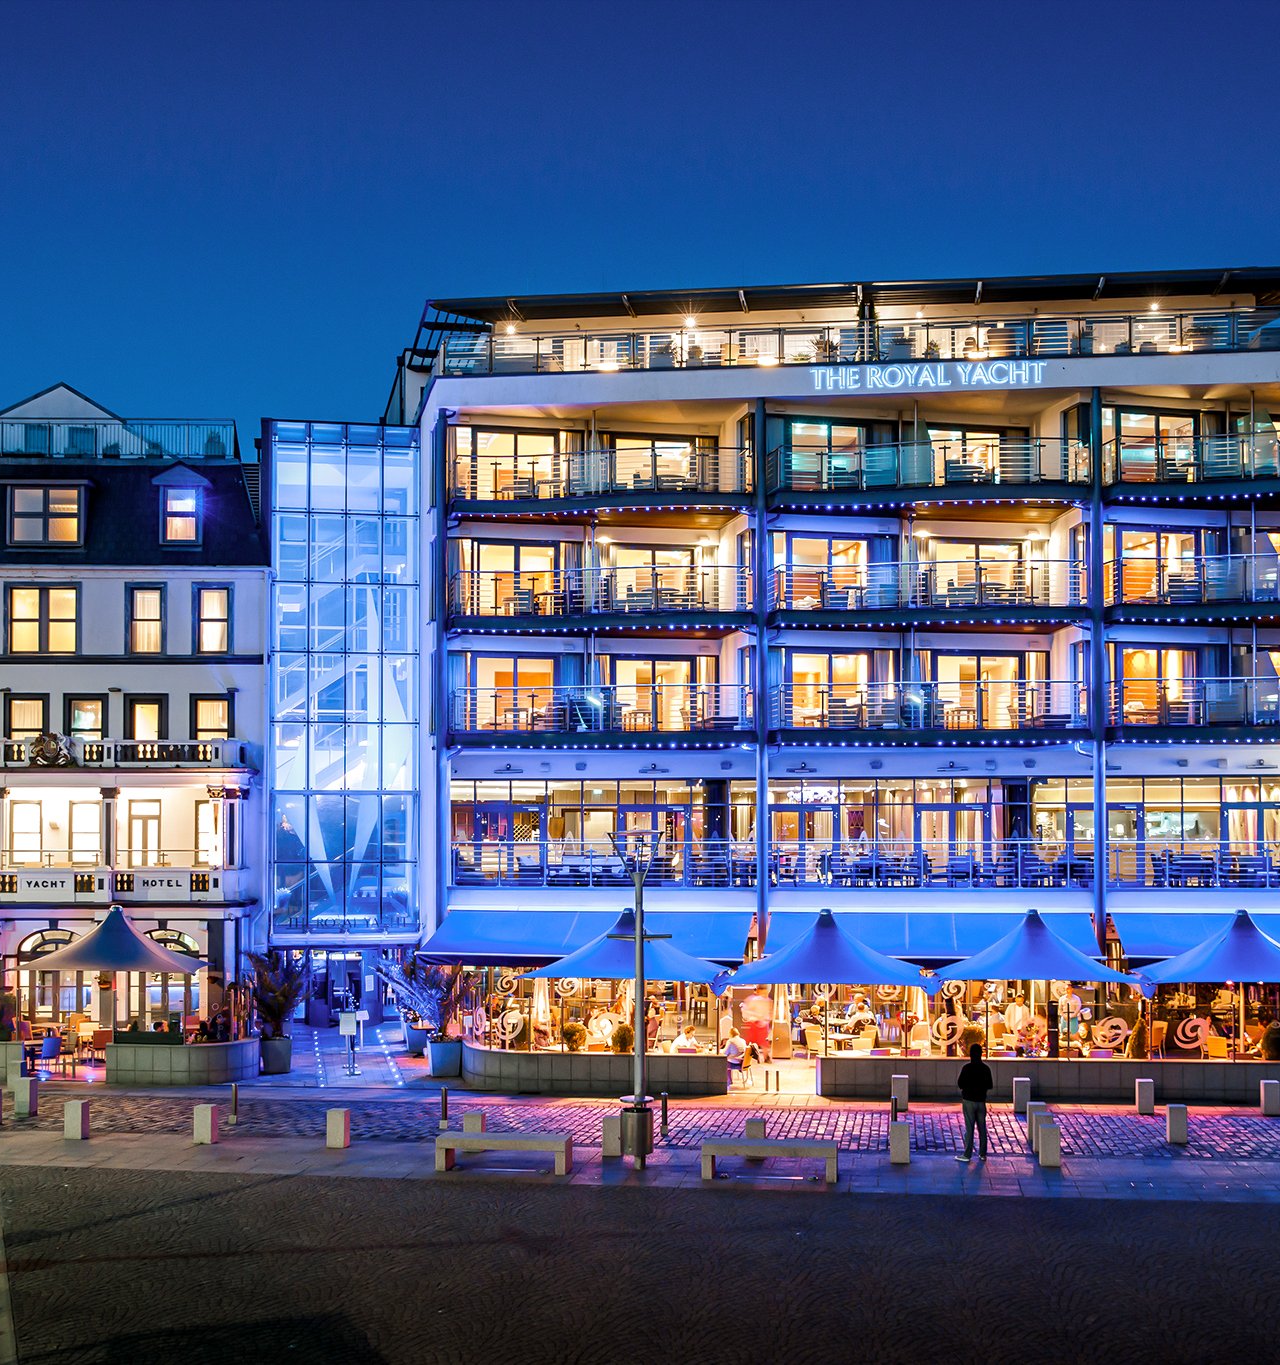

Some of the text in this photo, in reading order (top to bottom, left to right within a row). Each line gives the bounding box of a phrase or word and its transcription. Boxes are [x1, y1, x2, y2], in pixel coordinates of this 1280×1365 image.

[810, 361, 1048, 390] THE ROYAL YACHT
[26, 880, 66, 888] YACHT
[142, 879, 183, 887] HOTEL
